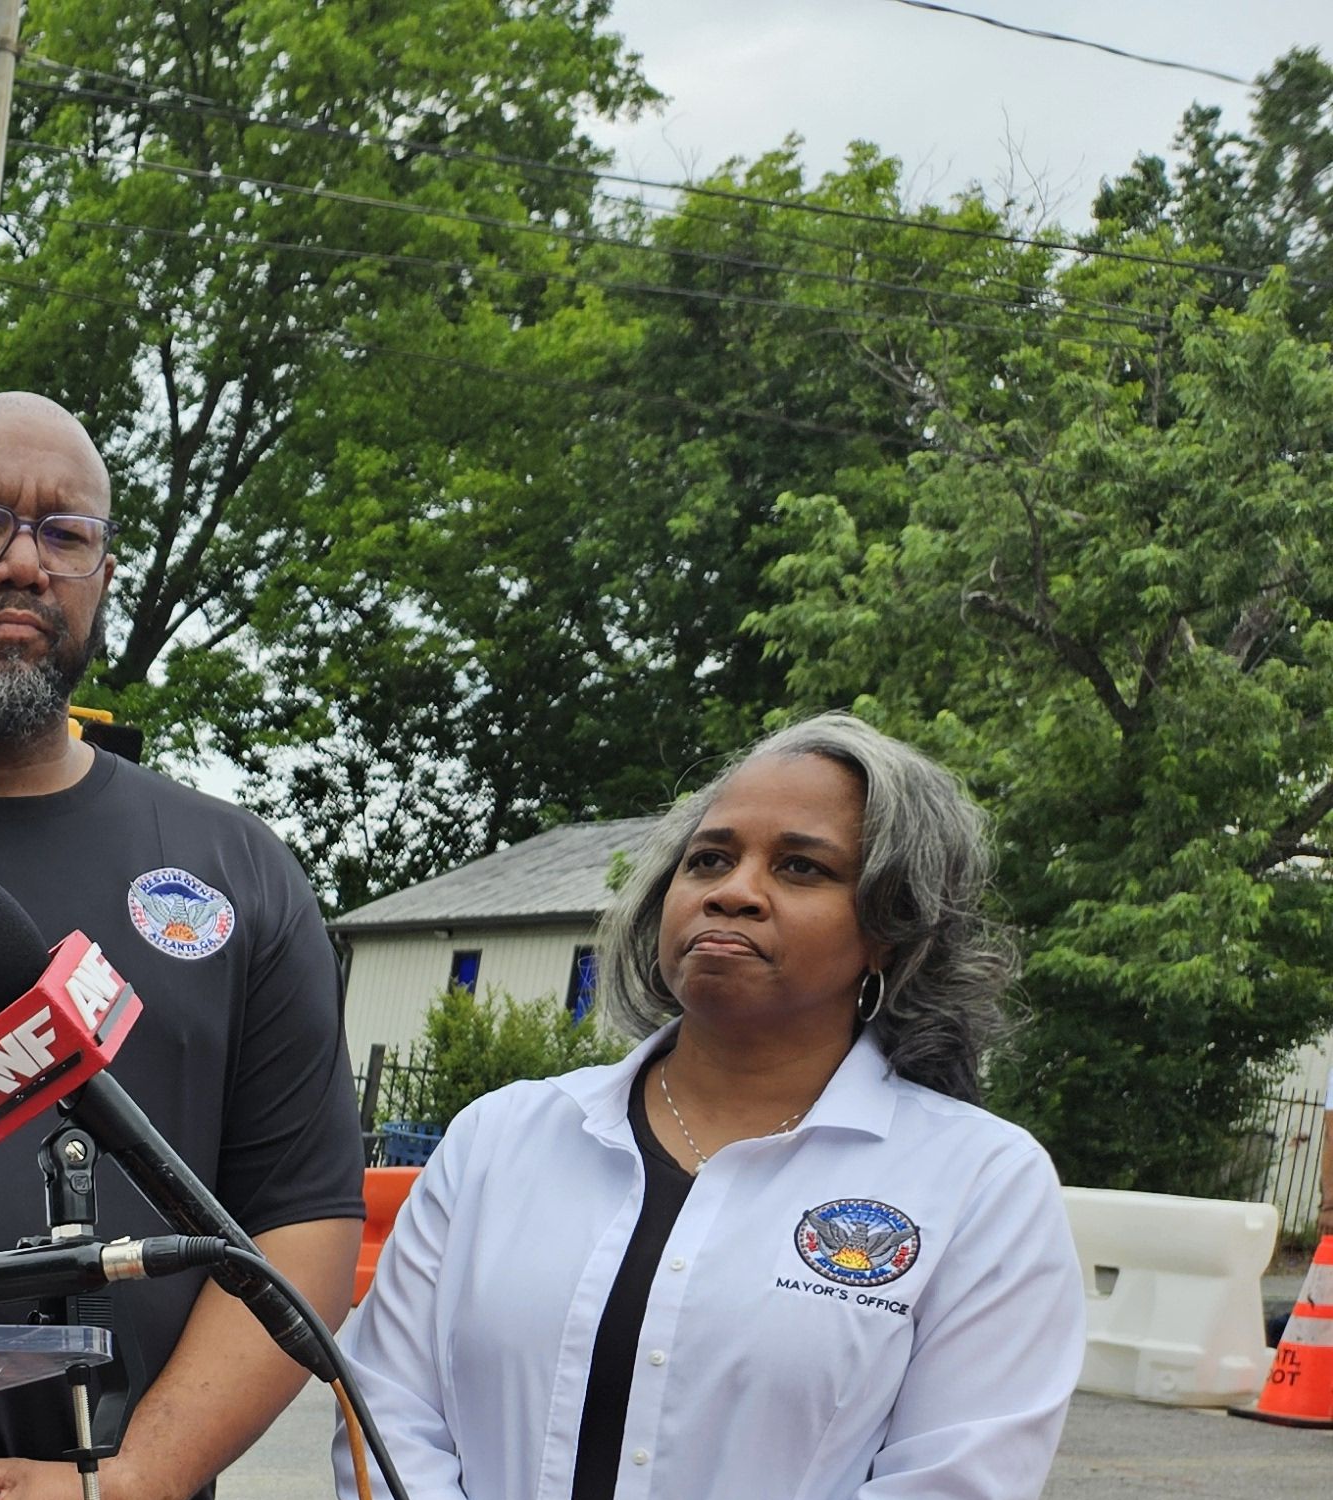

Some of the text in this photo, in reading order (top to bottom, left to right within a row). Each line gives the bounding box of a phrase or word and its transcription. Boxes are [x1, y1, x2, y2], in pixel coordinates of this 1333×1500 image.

[65, 941, 120, 1031] ANF
[775, 1277, 910, 1315] MAYOR'S OFFICE
[1277, 1348, 1301, 1366] TL
